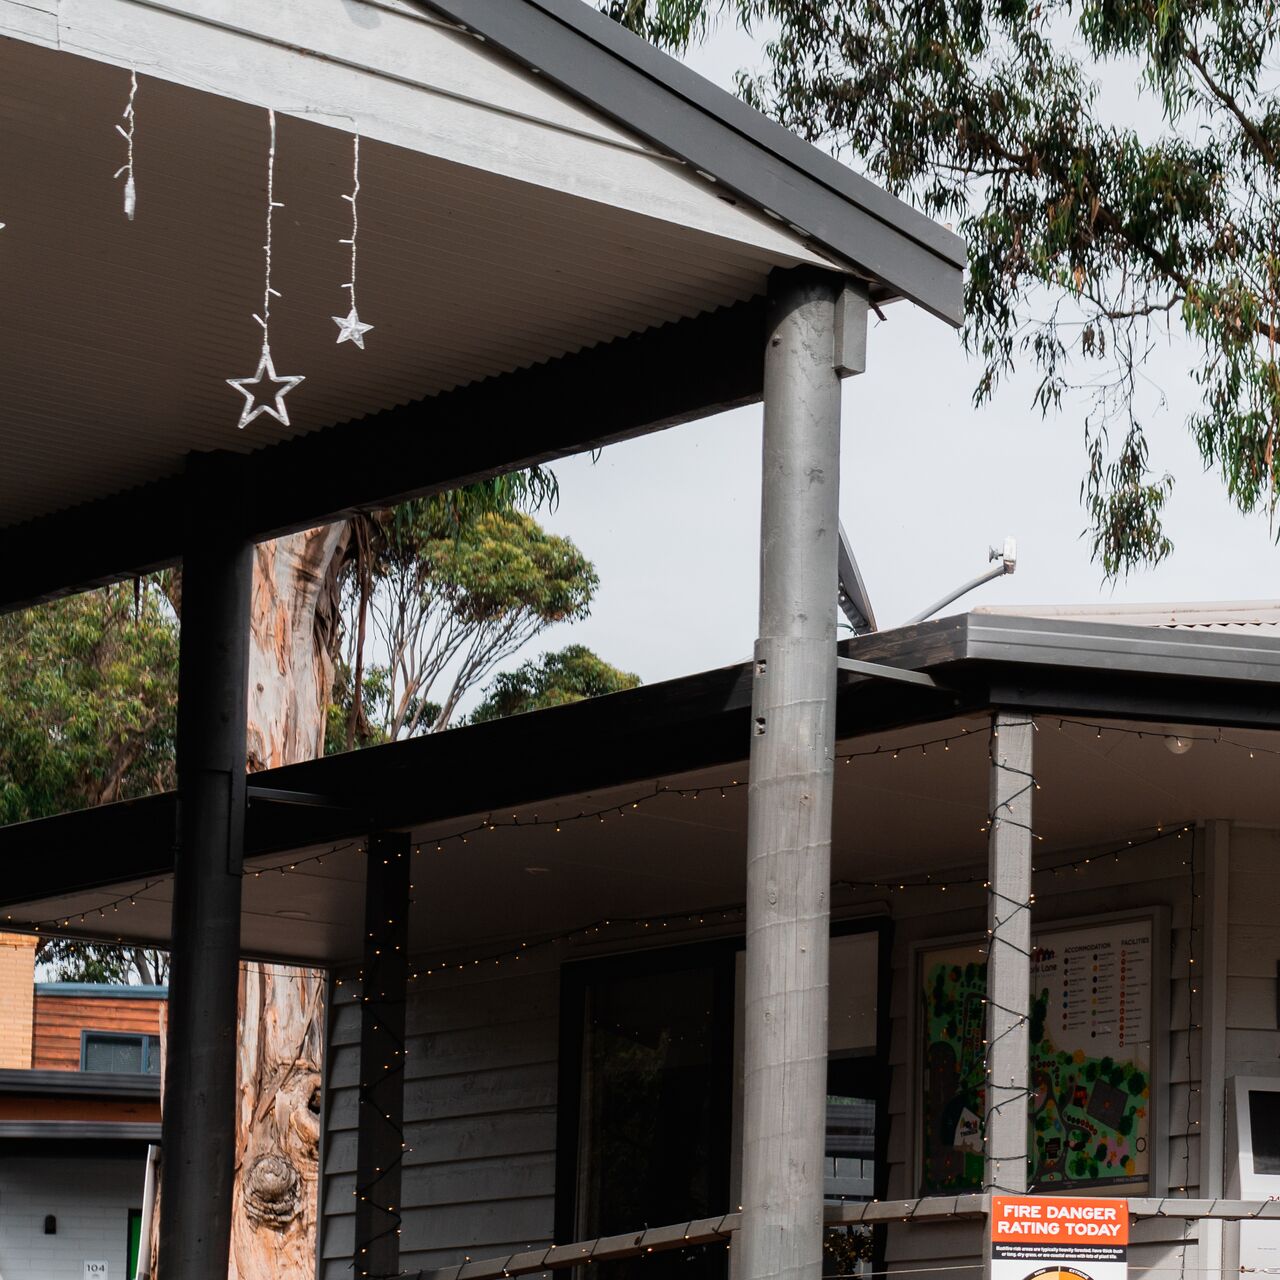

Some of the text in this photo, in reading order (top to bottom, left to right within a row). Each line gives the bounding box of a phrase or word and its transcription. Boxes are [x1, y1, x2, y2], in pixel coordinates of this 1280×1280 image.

[1121, 937, 1149, 946] FACILITIES
[1064, 943, 1111, 954] ACCOMMODATION
[1041, 964, 1057, 973] Lane
[1003, 1204, 1117, 1221] FIRE DANGER
[997, 1221, 1122, 1238] RATING TODAY
[87, 1263, 105, 1272] 104
